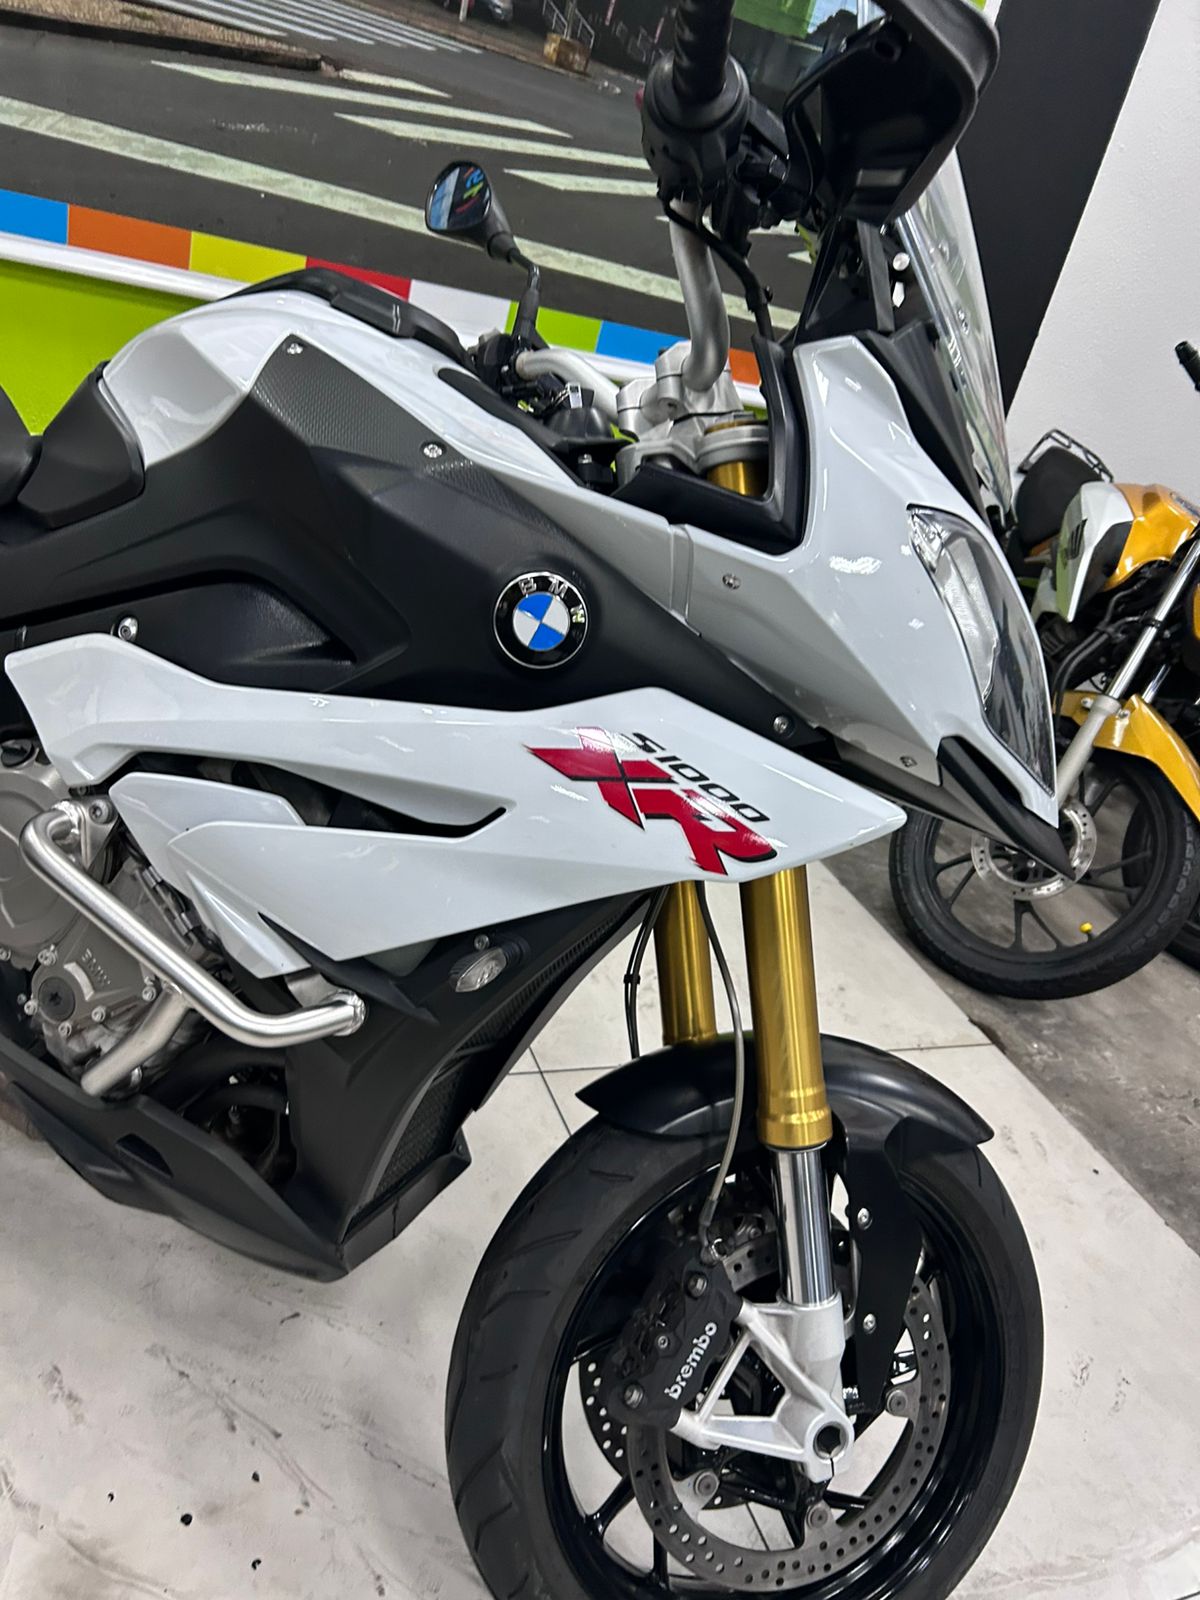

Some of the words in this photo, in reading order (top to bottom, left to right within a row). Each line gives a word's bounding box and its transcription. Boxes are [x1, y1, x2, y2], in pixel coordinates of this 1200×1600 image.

[518, 577, 586, 624] BMW
[522, 727, 778, 876] XR
[620, 732, 771, 822] S1000
[664, 1322, 717, 1400] brembo
